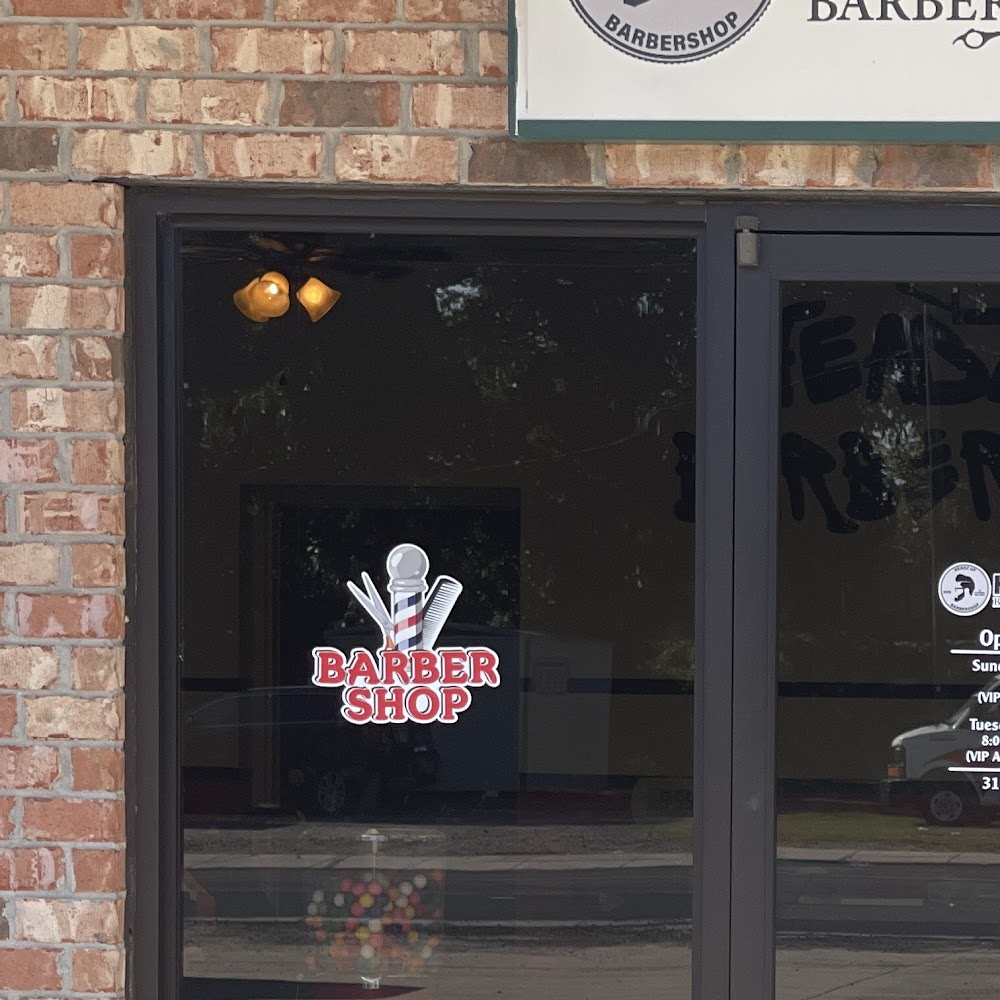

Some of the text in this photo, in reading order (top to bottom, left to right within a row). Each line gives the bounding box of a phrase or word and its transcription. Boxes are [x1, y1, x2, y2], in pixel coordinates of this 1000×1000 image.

[604, 11, 738, 51] BARBERSHOP
[314, 649, 499, 686] BARBER
[344, 686, 471, 723] SHOP
[977, 692, 1000, 704] (VIP
[966, 750, 989, 762] (VIP
